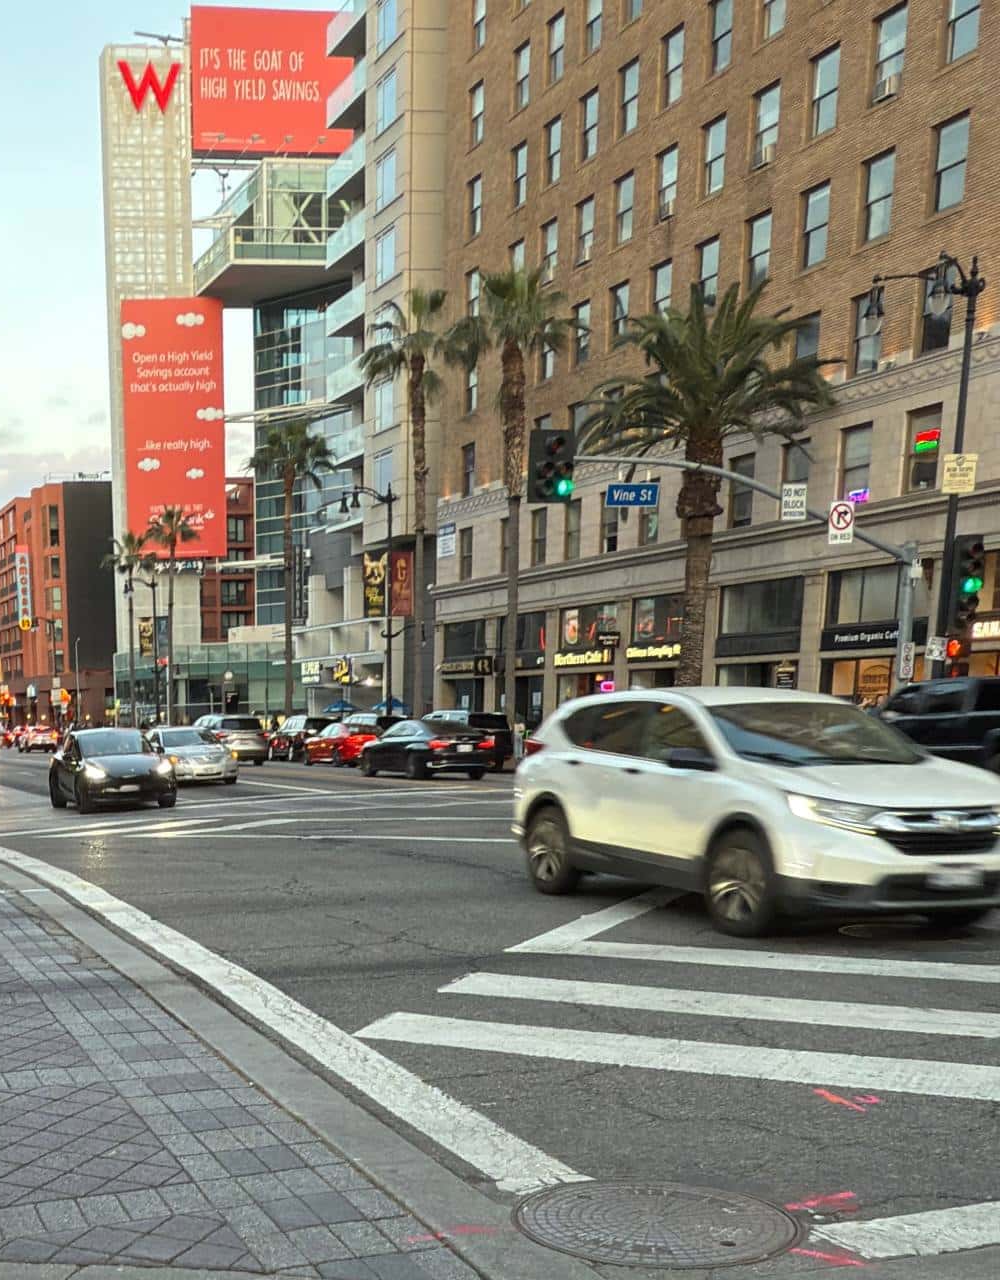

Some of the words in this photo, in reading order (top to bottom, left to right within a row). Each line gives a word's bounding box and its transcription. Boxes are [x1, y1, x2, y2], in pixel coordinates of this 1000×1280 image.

[200, 48, 220, 70] IT'S
[227, 48, 247, 71] THE
[254, 50, 283, 72] GOAT
[289, 51, 304, 72] OF
[117, 60, 182, 114] W
[200, 77, 227, 99] HIGH
[234, 79, 266, 100] YIELD
[272, 79, 320, 102] SAVINGS
[132, 352, 157, 365] Open
[159, 354, 166, 363] a
[168, 352, 189, 364] High
[191, 351, 213, 361] Yield
[136, 367, 172, 380] Savings
[174, 366, 210, 377] account
[130, 382, 157, 392] that's
[158, 381, 194, 393] actually
[196, 380, 217, 393] high
[163, 439, 188, 452] really
[613, 489, 636, 501] Vine
[640, 489, 652, 501] St
[834, 633, 859, 643] Premium
[860, 631, 884, 643] Organic
